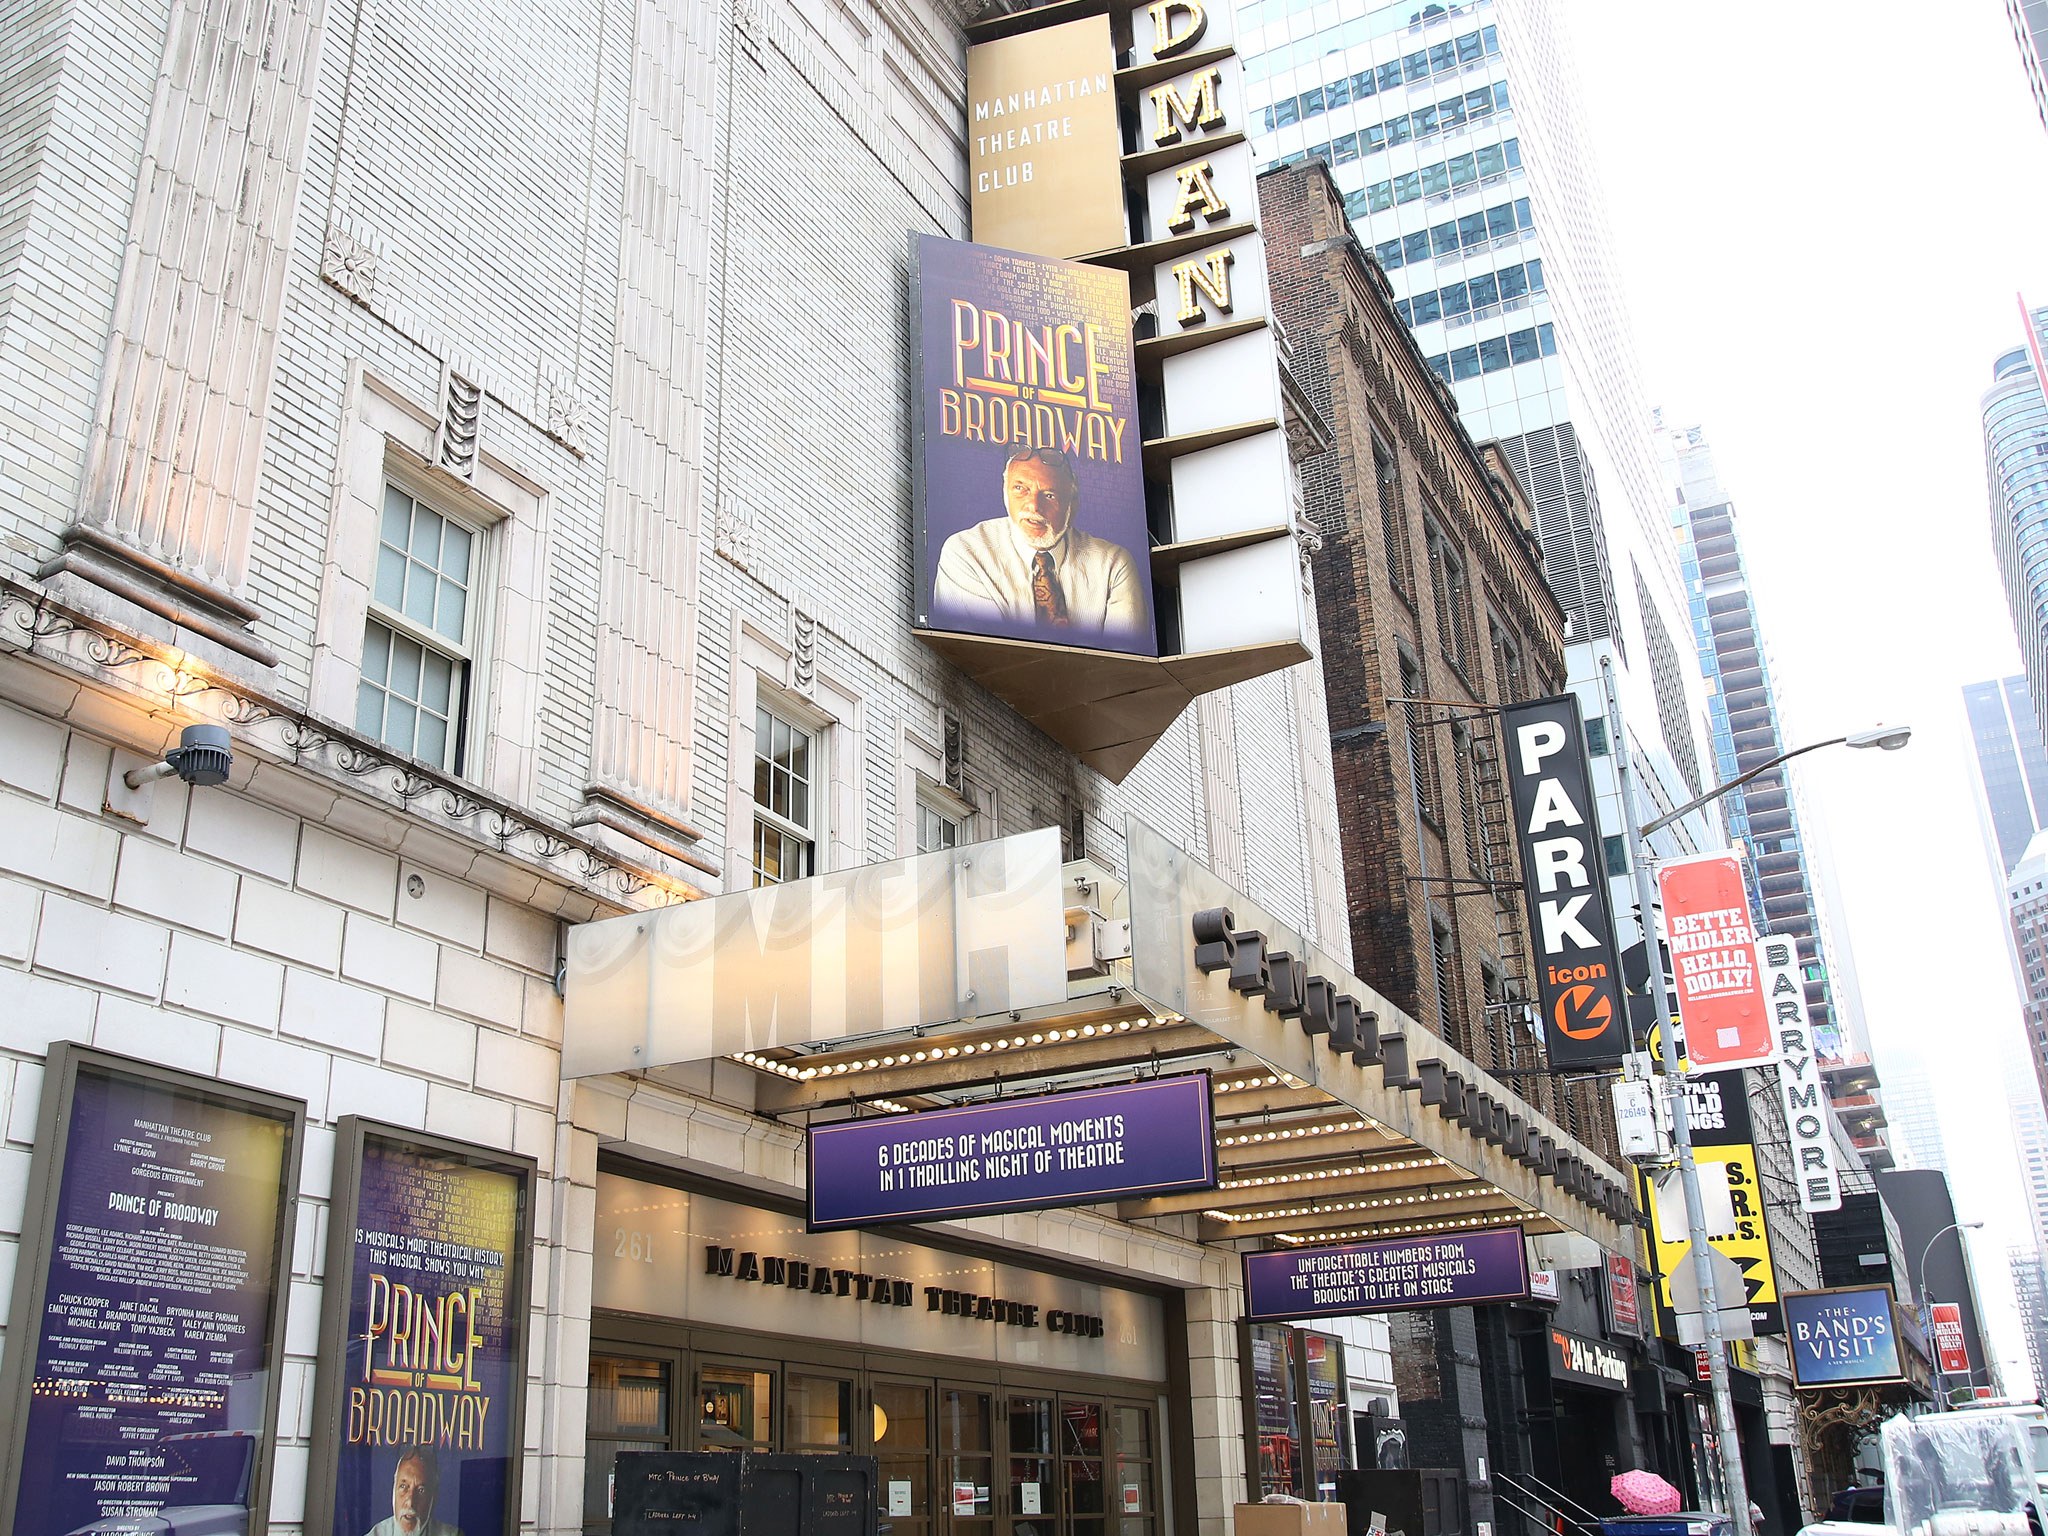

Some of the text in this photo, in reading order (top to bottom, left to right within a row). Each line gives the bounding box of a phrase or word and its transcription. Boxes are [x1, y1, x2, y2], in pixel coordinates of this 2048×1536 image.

[974, 72, 1108, 122] MANHATTAN
[977, 116, 1073, 157] THEATRE
[978, 160, 1035, 193] CLUB
[950, 298, 1114, 412] PRINCE
[1021, 385, 1035, 401] OF
[939, 388, 1127, 464] BROADWAY
[1517, 720, 1602, 955] PARK
[1672, 907, 1744, 935] BETTE
[1670, 926, 1752, 954] MIDLER
[1548, 963, 1607, 985] icon
[1679, 950, 1753, 976] HELLO,
[1683, 968, 1753, 995] DOLLY!
[1766, 944, 1831, 1202] BARRYMORE
[1619, 1107, 1647, 1119] 726149
[1630, 1099, 1636, 1107] C
[134, 1119, 212, 1143] MANHATTAN THEATRE CLUB
[878, 1114, 1125, 1168] 6 DECADES OF MAGICAL MOMENTS
[114, 1143, 157, 1159] LYNNE MEADOW
[131, 1166, 204, 1187] GORGEOUS ENTERTAINMENT
[190, 1158, 225, 1173] BARRY GROVE
[880, 1141, 1125, 1191] IN 1 THRILLING NIGHT OF THEATRE
[108, 1192, 219, 1226] PRINCE OF BROADWAY
[365, 1231, 405, 1250] MUSICALS
[407, 1238, 428, 1254] MADE
[430, 1240, 472, 1261] THEATRICAL
[1298, 1244, 1464, 1273] UNFORGETTABLE NUMBERS FROM
[369, 1248, 486, 1280] THIS MUSICAL SHOWS YOU WHY.
[1290, 1259, 1476, 1291] THE THEATRE'S GREATEST MUSICALS
[614, 1226, 654, 1264] 261
[705, 1244, 914, 1308] MANHATTAN
[923, 1286, 1039, 1328] THEATRE
[1046, 1309, 1105, 1339] CLUB
[1313, 1278, 1454, 1305] BROUGHT TO LIFE ON STAGE
[1531, 1272, 1550, 1286] TOMP
[48, 1303, 98, 1318] EMILY SKINNER
[59, 1293, 110, 1308] CHUCK COOPER
[118, 1300, 159, 1314] JANET DACAL
[1824, 1306, 1850, 1317] THE
[67, 1316, 121, 1331] MICHAEL XAVIER
[105, 1310, 174, 1326] BRANDON URANOWITZ
[166, 1306, 239, 1323] BRYONHA MARIE PARHAM
[182, 1319, 246, 1335] KALEY ANN VOORHEES
[130, 1323, 176, 1337] TONY YAZBECK
[184, 1330, 228, 1343] KAREN ZIEMBA
[362, 1273, 484, 1393] PRINCE
[1796, 1315, 1886, 1342] BAND'S
[1808, 1336, 1875, 1360] VISIT
[1569, 1338, 1584, 1373] 24
[1582, 1341, 1597, 1376] hr.
[1594, 1345, 1628, 1389] Parking
[414, 1370, 425, 1388] OF
[346, 1387, 491, 1450] BROADWAY
[106, 1455, 165, 1468] DAVID THOMPSON
[94, 1480, 171, 1493] JASON ROBERT BROWN
[101, 1506, 159, 1518] SUSAN STROMAN
